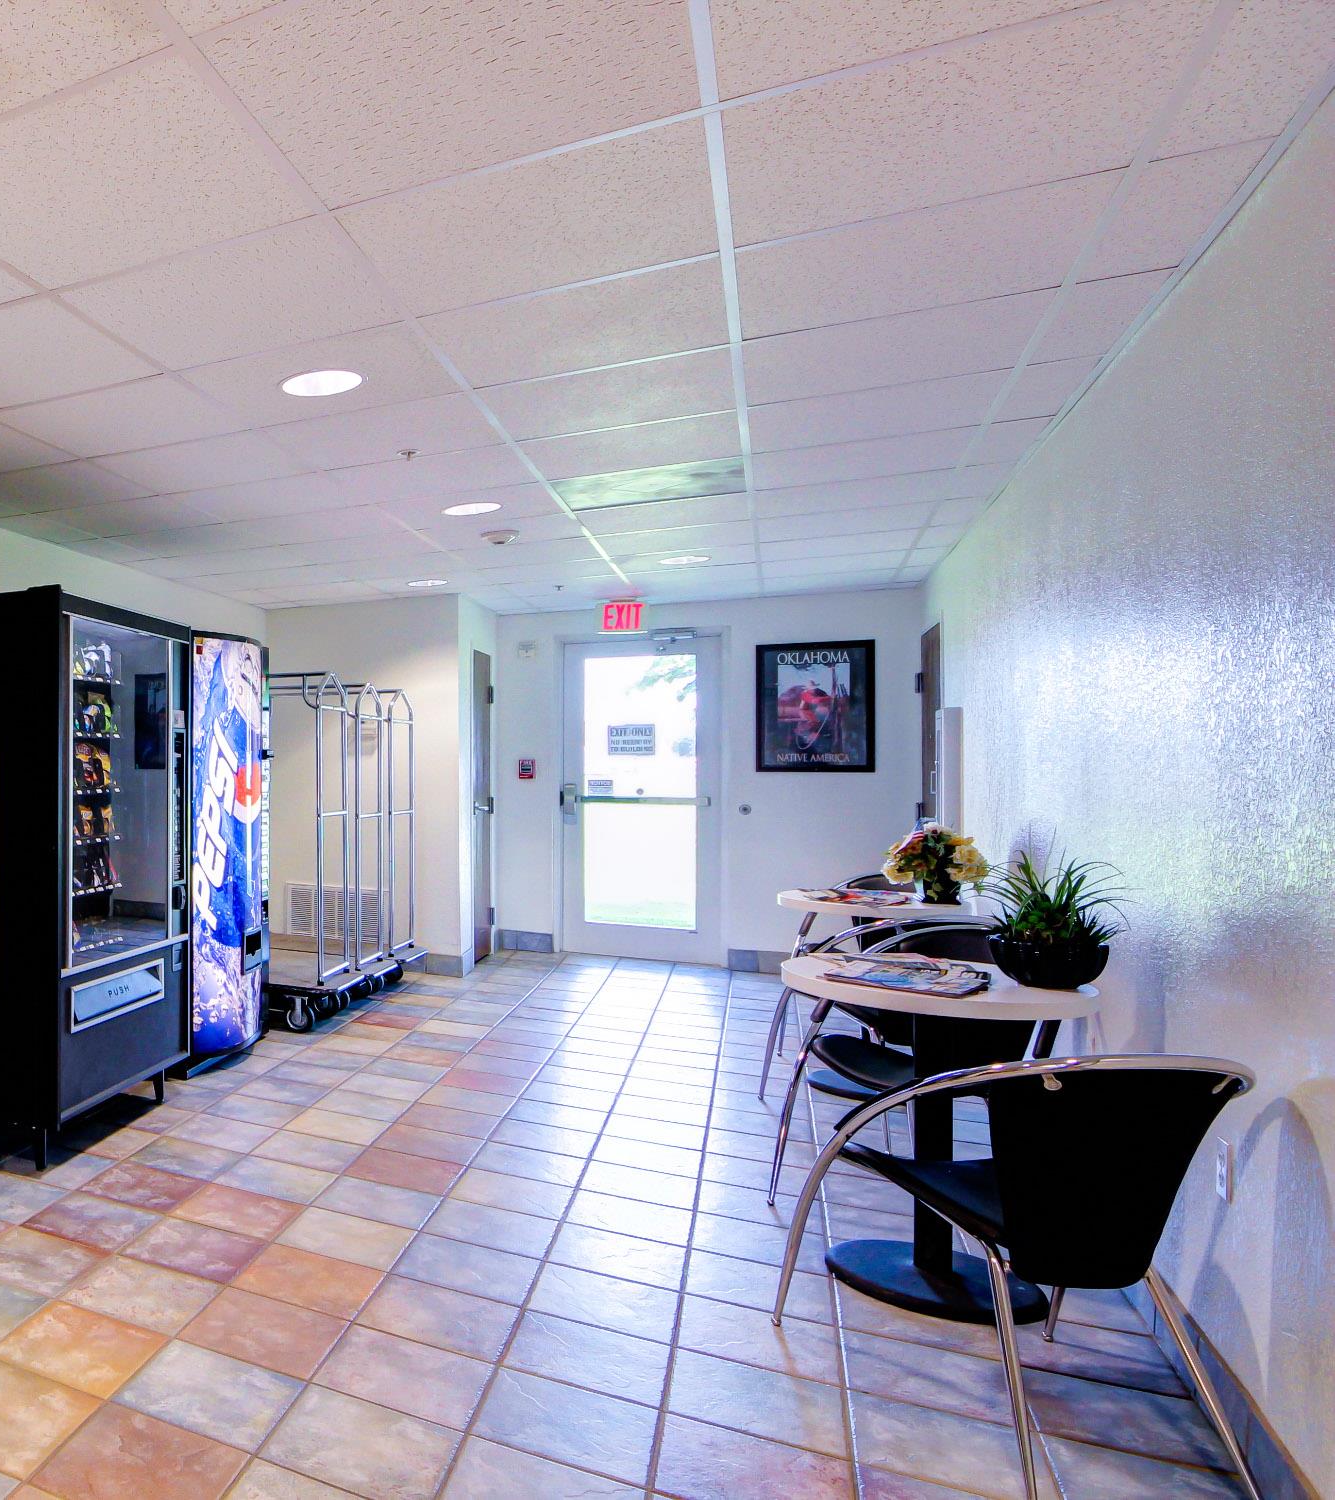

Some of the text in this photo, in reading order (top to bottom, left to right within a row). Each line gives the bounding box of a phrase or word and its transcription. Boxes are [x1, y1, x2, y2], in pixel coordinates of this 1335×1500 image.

[603, 603, 644, 630] EXIT
[777, 651, 850, 665] OKLAHOMA
[610, 727, 653, 737] EXIT ONLY
[777, 752, 850, 763] NATIVE AMERICA
[192, 716, 239, 931] PEPSI
[108, 984, 130, 998] PUSH
